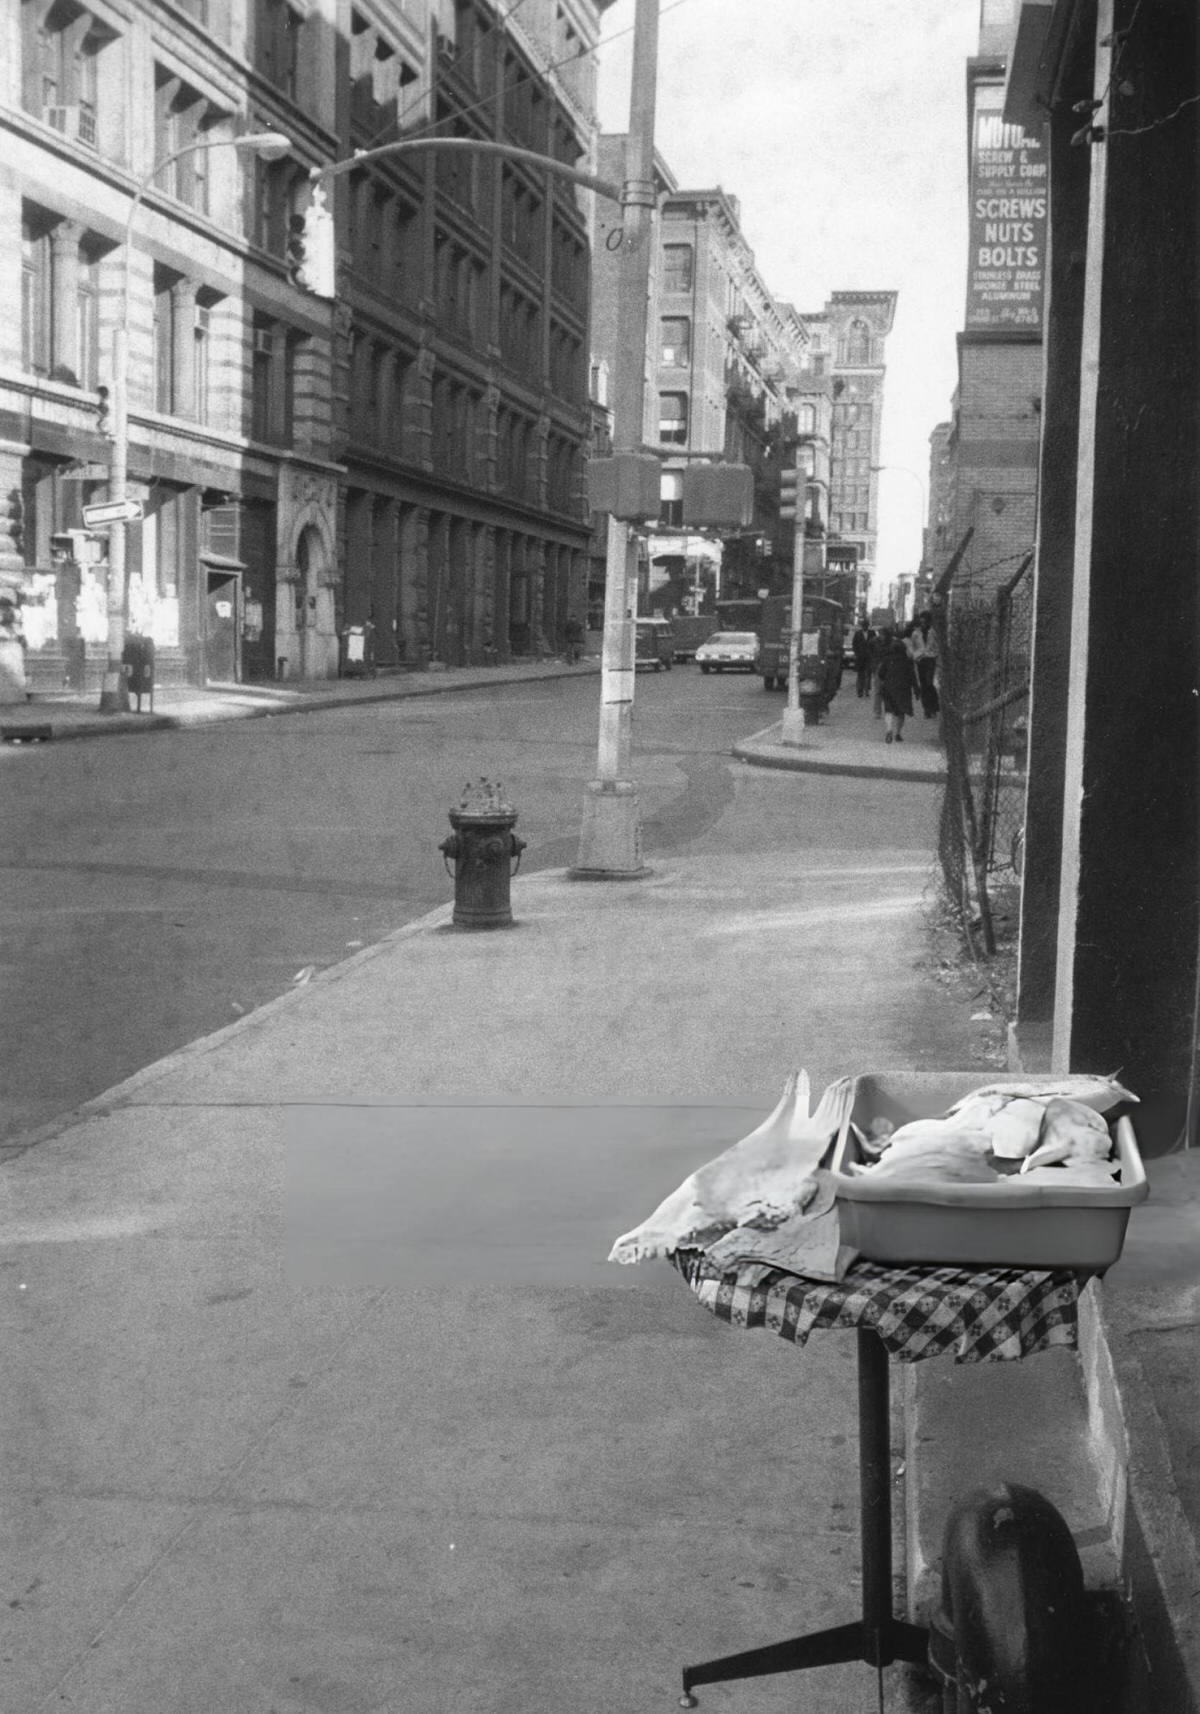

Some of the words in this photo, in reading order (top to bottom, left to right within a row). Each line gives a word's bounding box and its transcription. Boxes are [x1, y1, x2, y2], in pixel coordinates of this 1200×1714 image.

[978, 151, 1014, 164] SCREW
[1020, 150, 1028, 164] &
[978, 164, 1016, 178] SUPPLY
[975, 198, 1047, 219] SCREWS
[984, 222, 1035, 243] NUTS
[978, 246, 1039, 267] BOLTS
[973, 270, 1012, 281] STAINLESS
[1015, 270, 1042, 281] BRASS
[973, 281, 1007, 291] BRONZE
[1014, 281, 1041, 291] STEEL
[981, 292, 1031, 301] ALUMINUM
[829, 562, 855, 573] WALK
